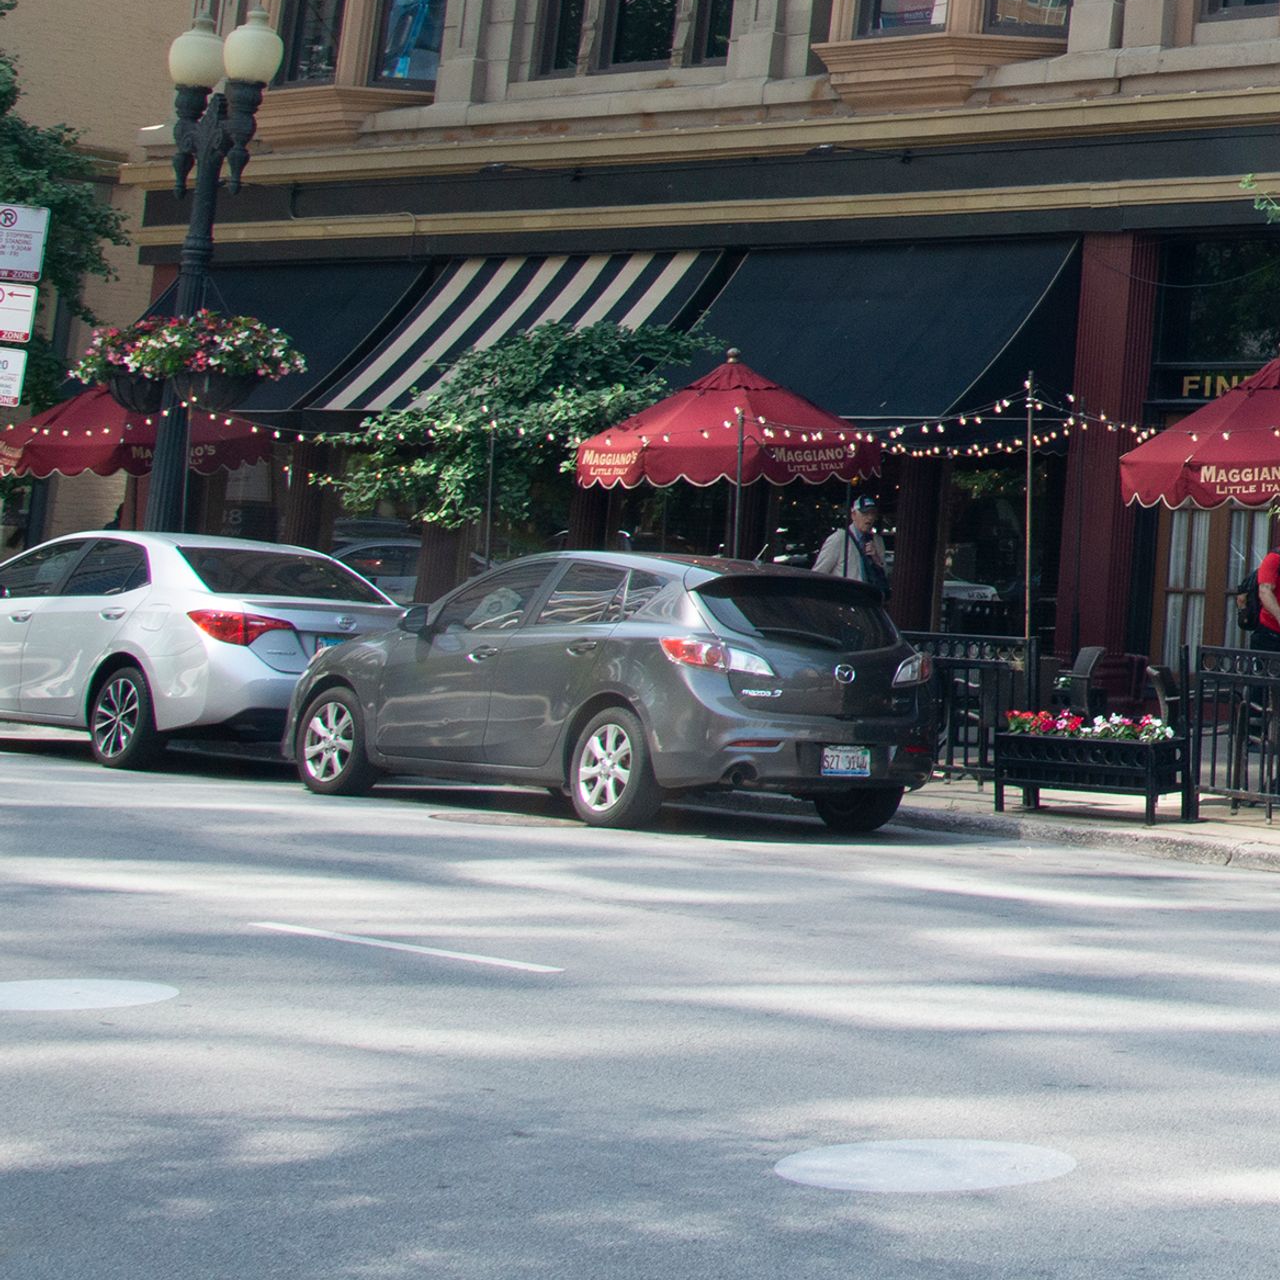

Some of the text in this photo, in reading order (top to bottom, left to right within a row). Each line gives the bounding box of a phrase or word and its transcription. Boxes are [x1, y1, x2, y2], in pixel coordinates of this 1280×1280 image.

[12, 271, 35, 279] ZONE
[2, 331, 25, 340] ZONE
[1182, 376, 1254, 397] FIN
[582, 449, 638, 466] MAGGIANO'S
[775, 445, 856, 462] MAGGIANO'S
[590, 467, 629, 476] LITTLE ITALY
[787, 461, 844, 473] LITTLE ITALY
[1216, 485, 1256, 494] LITTLE
[742, 689, 771, 697] mazda
[824, 754, 840, 769] S27
